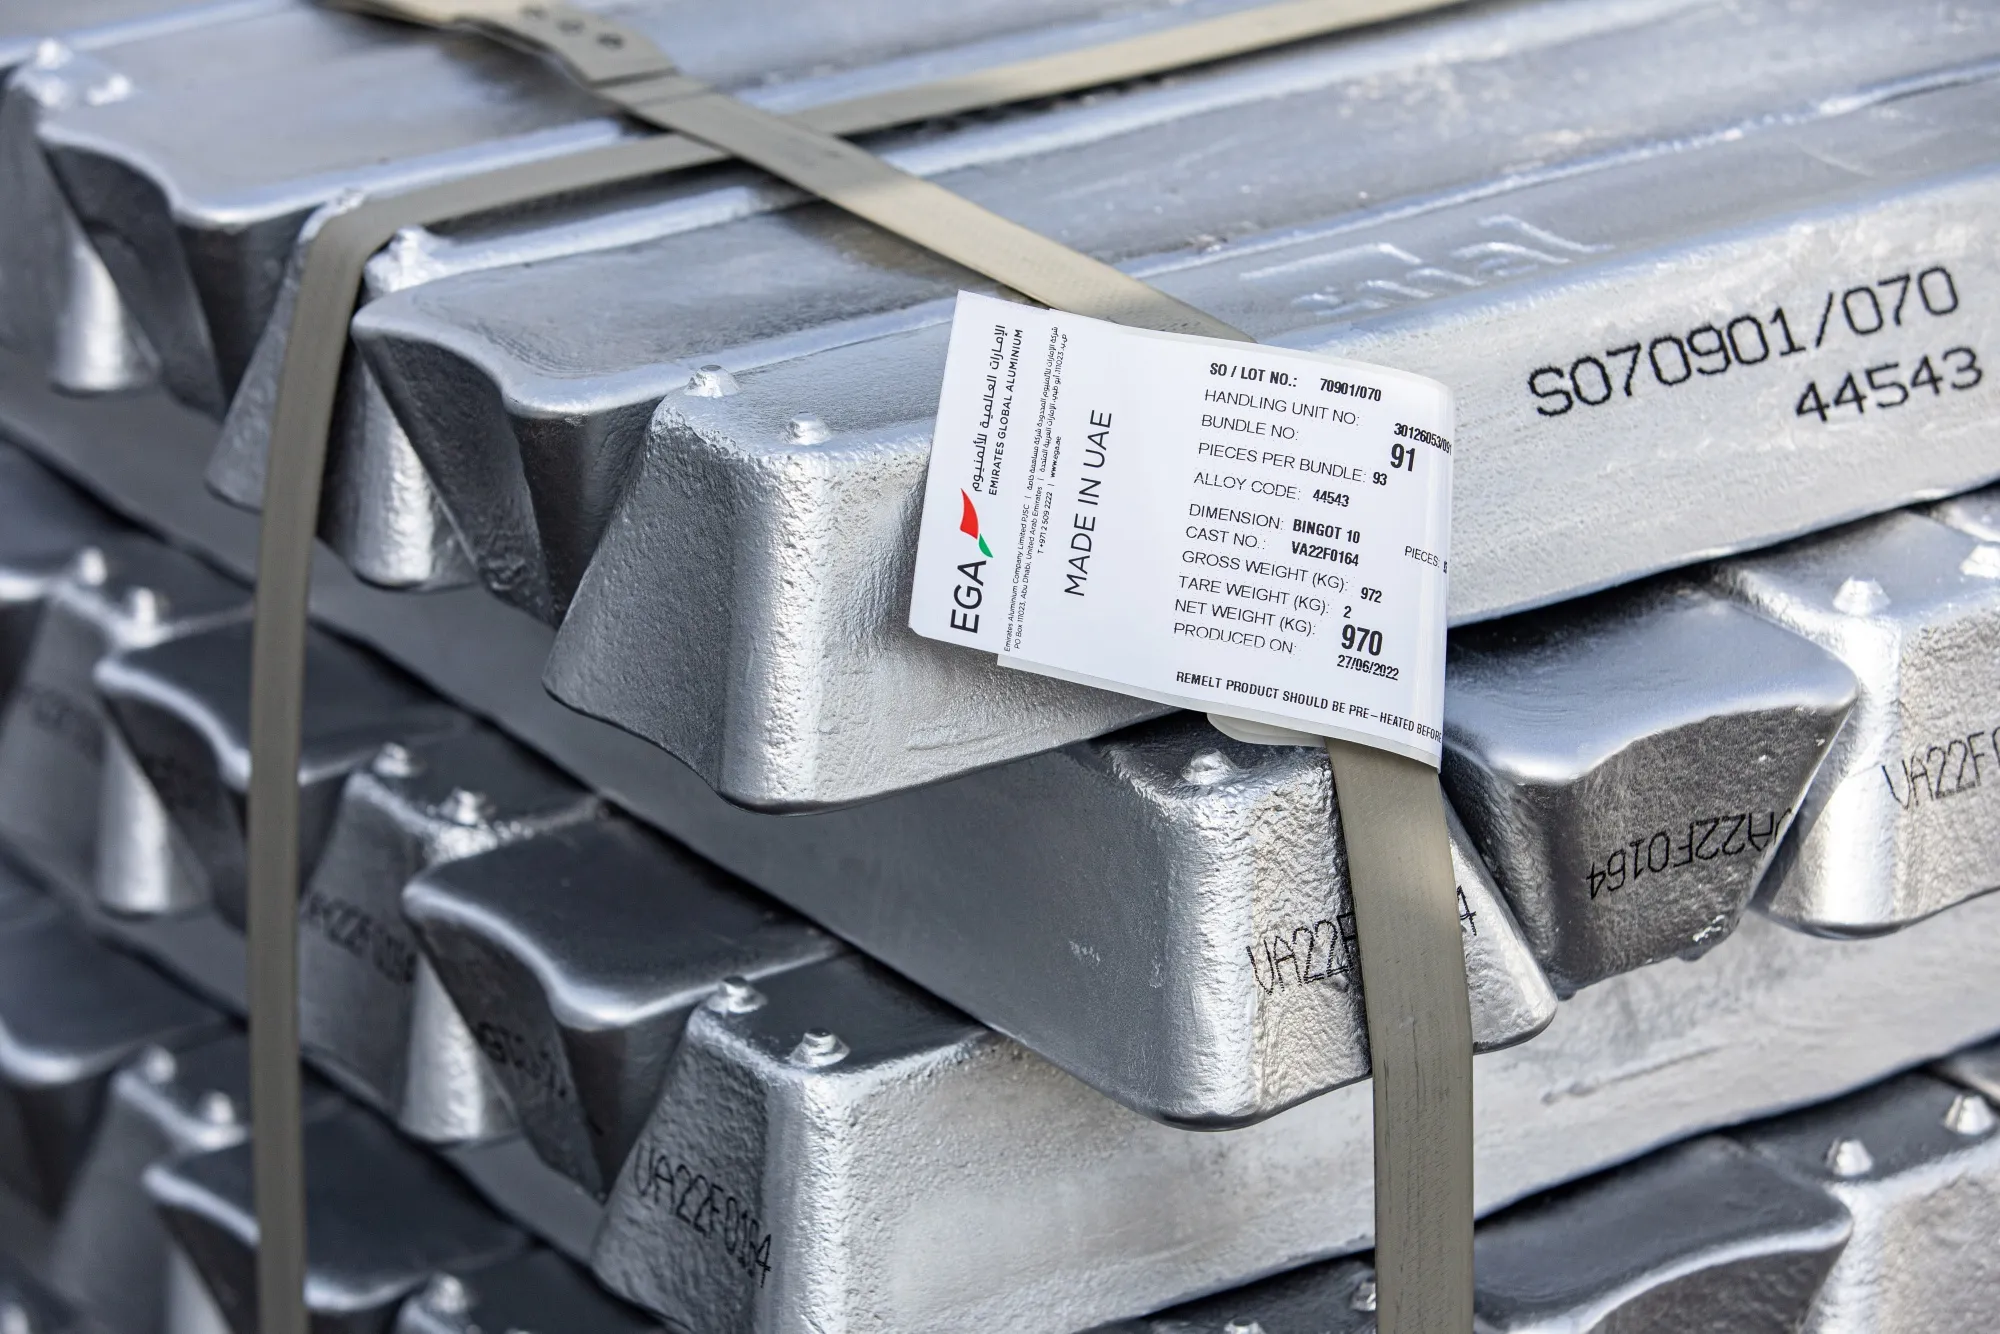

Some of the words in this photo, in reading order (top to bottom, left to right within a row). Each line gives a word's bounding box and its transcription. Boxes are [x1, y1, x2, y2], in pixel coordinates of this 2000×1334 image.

[989, 324, 1008, 370] الإمارات
[1209, 362, 1228, 377] SO
[1240, 366, 1266, 382] LOT
[1269, 370, 1298, 388] NO.:
[1319, 378, 1382, 401] 70901/070
[1795, 346, 1984, 423] 44543
[979, 375, 997, 429] العالمية
[989, 441, 1005, 496] EMIRATES
[997, 394, 1013, 440] GLOBAL
[1005, 329, 1023, 393] ALUMINIUM
[1204, 388, 1288, 413] HANDLING
[1291, 402, 1329, 420] UNIT
[1332, 409, 1360, 426] NO:
[1050, 436, 1062, 478] www.ega.ae
[1082, 409, 1112, 469] UAE
[1201, 414, 1266, 436] BUNDLE
[1270, 424, 1300, 441] NO:
[1390, 443, 1416, 472] 91
[1198, 442, 1258, 463] PIECES
[1262, 452, 1296, 469] PER
[1299, 458, 1367, 483] BUNDLE:
[1372, 471, 1388, 486] 93
[1031, 486, 1042, 517] Emirates
[1044, 491, 1053, 510] 2222
[1078, 477, 1102, 506] IN
[1193, 471, 1247, 491] ALLOY
[1251, 480, 1301, 500] CODE:
[1312, 489, 1350, 508] 44543
[1021, 503, 1030, 523] PJSC
[1029, 517, 1038, 536] Arab
[1042, 510, 1050, 525] 509
[1188, 503, 1285, 531] DIMENSION:
[1292, 518, 1342, 541] BINGOT
[1346, 529, 1361, 544] 10
[1017, 523, 1027, 550] Limited
[1026, 536, 1035, 560] United
[1064, 513, 1096, 597] MADE
[1185, 526, 1229, 544] CAST
[1291, 541, 1360, 566] VA22F0164
[1012, 551, 1023, 584] Company
[1182, 550, 1241, 571] GROSS
[1245, 559, 1309, 583] WEIGHT
[1312, 572, 1349, 592] (KG):
[1360, 586, 1383, 604] 972
[950, 560, 987, 634] EGA
[1008, 585, 1018, 622] Aluminium
[1020, 584, 1028, 600] Abu
[1178, 575, 1222, 594] TARE
[1226, 583, 1290, 605] WEIGHT
[1293, 594, 1330, 615] (KG):
[1343, 605, 1352, 619] 2
[1003, 623, 1014, 652] Emirates
[1013, 638, 1022, 650] PO
[1015, 624, 1023, 638] Box
[1174, 598, 1207, 616] NET
[1211, 604, 1276, 627] WEIGHT
[1279, 616, 1317, 637] (KG):
[1341, 623, 1383, 657] 970
[1173, 622, 1266, 649] PRODUCED
[1269, 638, 1297, 655] ON:
[1336, 654, 1400, 681] 27/06/2022
[1176, 671, 1223, 689] REMELT
[1226, 679, 1280, 700] PRODUCT
[1283, 690, 1329, 711] SHOULD
[1331, 700, 1347, 714] BE
[1416, 723, 1442, 744] BEFORE
